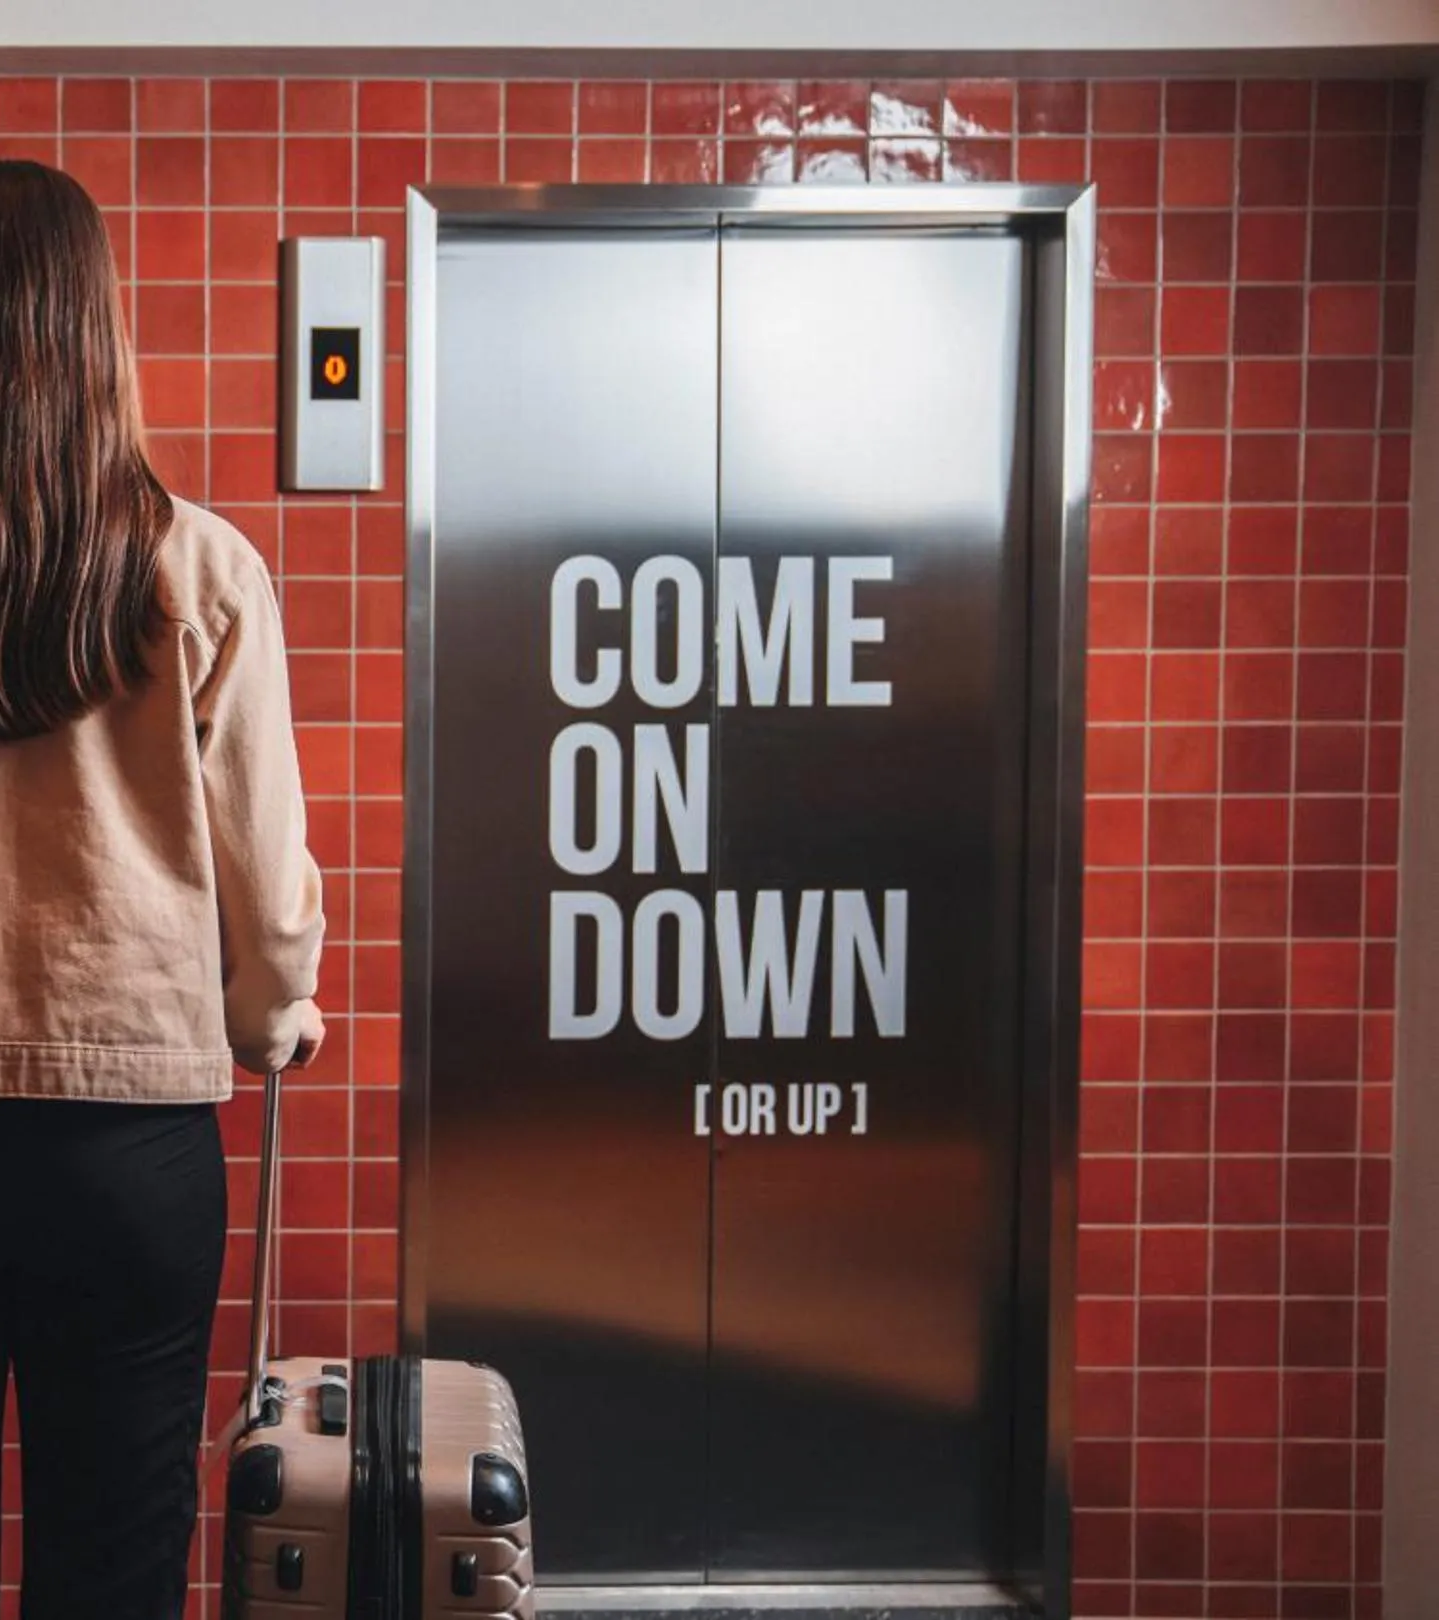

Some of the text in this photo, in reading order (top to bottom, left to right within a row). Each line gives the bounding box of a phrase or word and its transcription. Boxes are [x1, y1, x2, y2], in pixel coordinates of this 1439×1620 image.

[550, 554, 894, 709] COME
[549, 722, 710, 876] ON
[549, 889, 909, 1041] DOWN
